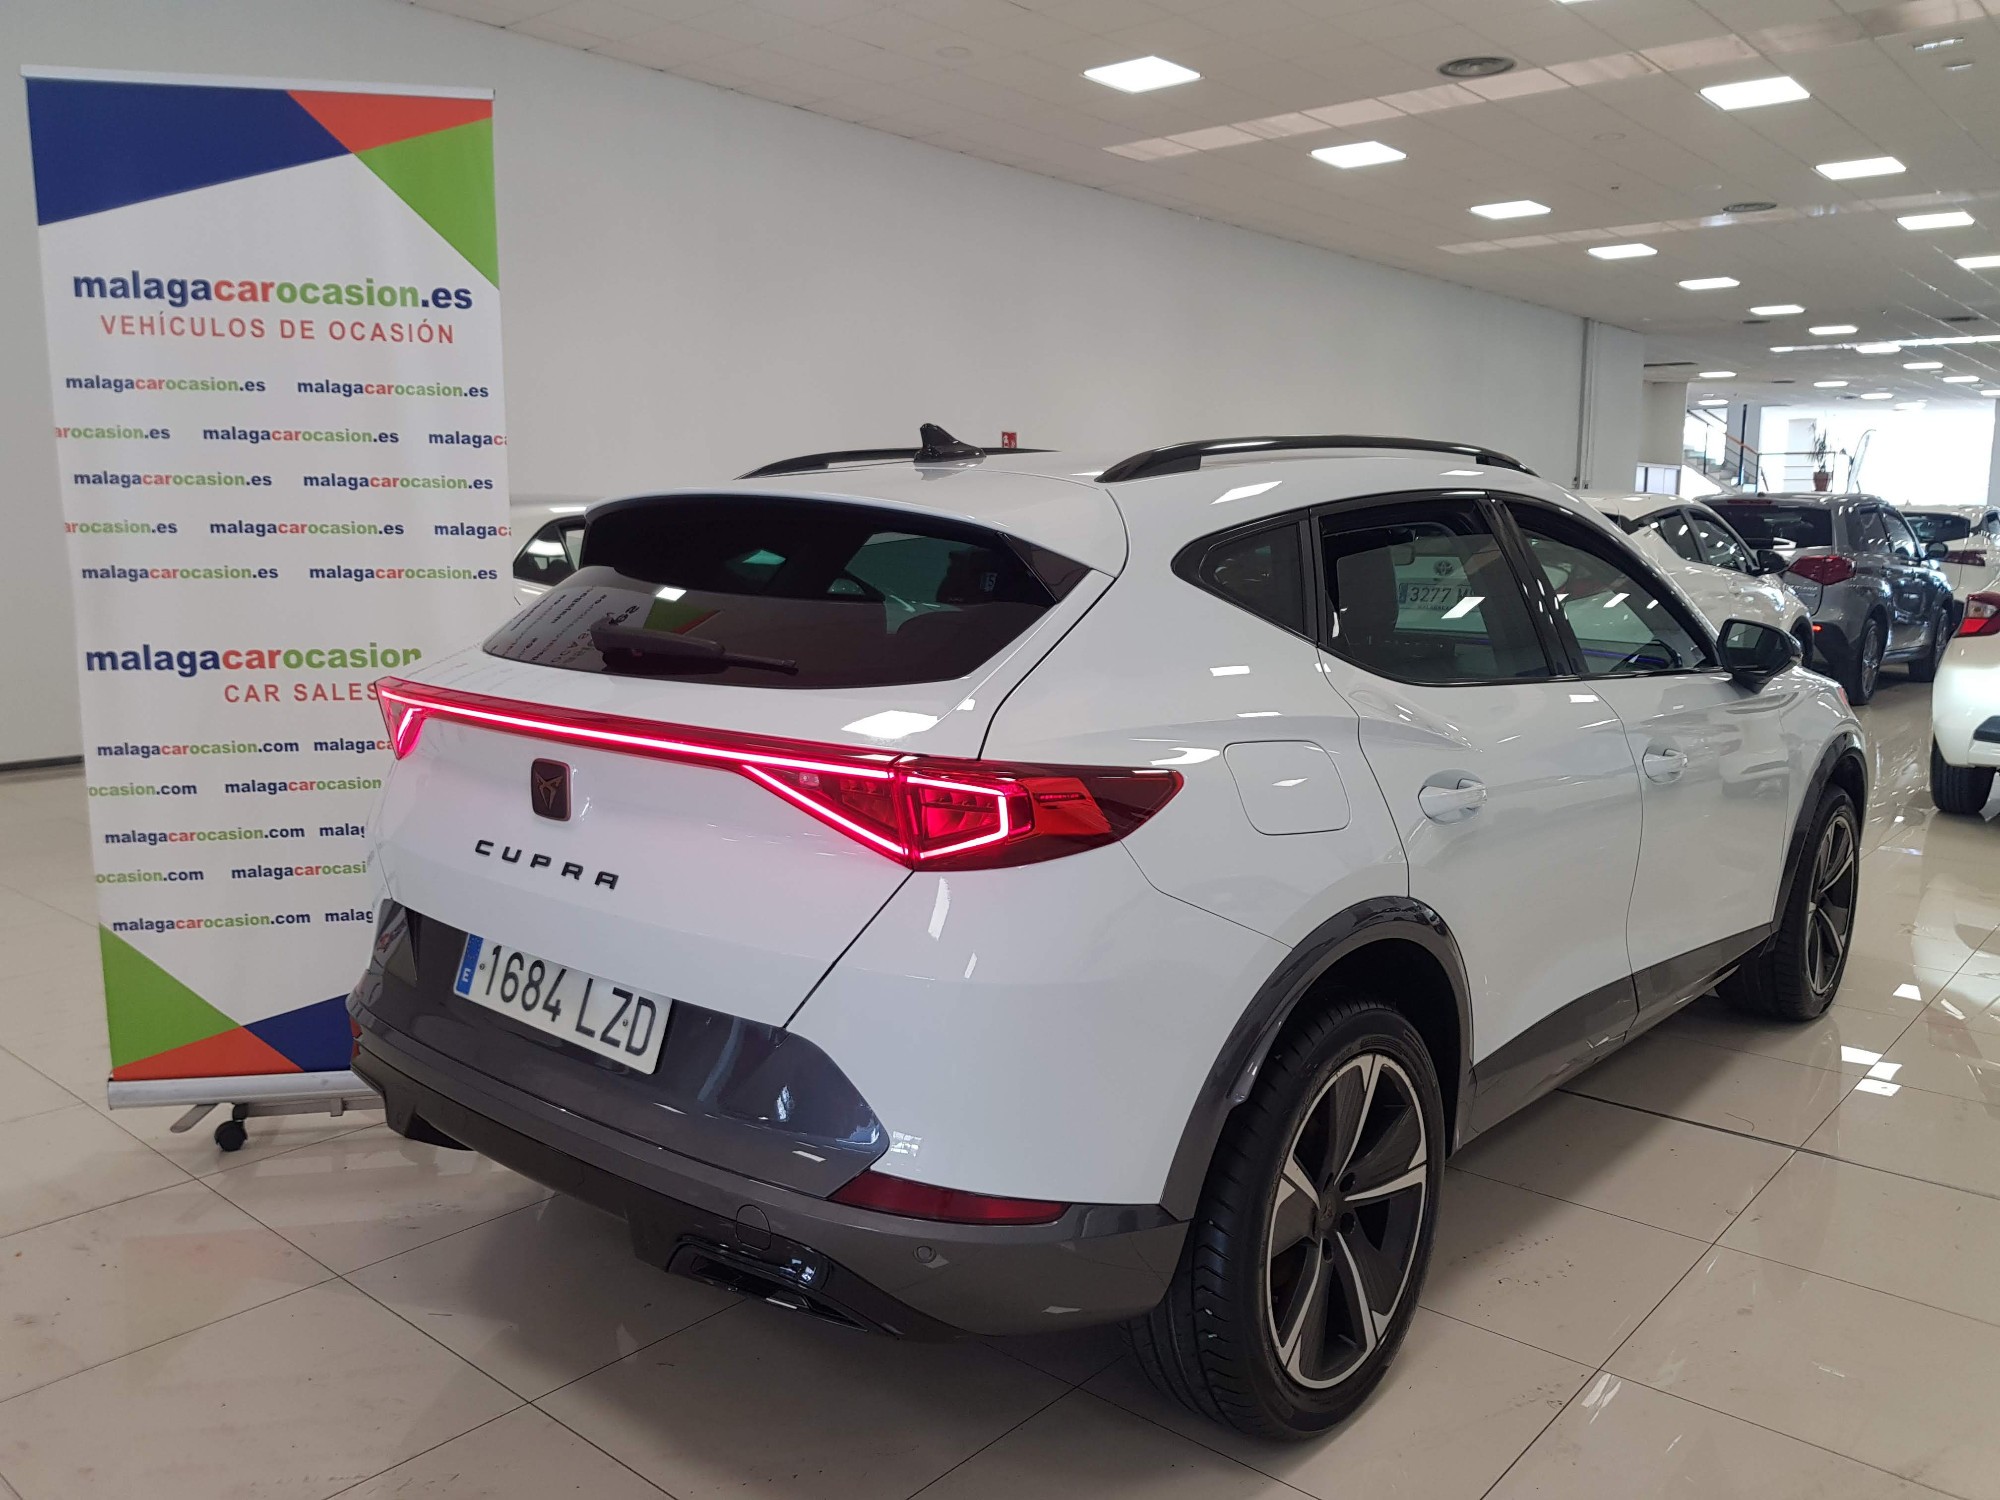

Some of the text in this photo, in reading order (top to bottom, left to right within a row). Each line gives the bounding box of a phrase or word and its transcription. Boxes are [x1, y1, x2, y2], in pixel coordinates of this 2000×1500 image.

[73, 269, 473, 309] malagacarocasion.es
[101, 311, 454, 344] VEHÍCULOS DE OCASIÓN
[65, 374, 489, 397] malagacarocasion.es malagacarocasion.es
[203, 425, 400, 444] malagacarocasion.es
[428, 430, 507, 448] malagac
[74, 470, 494, 490] malagacarocasion.es malagacarocasion.es
[209, 519, 405, 537] malagacarocasion.es
[434, 522, 511, 539] malagac
[82, 565, 498, 583] malagacarocasion.es malagacarocasion.es
[1409, 586, 1452, 603] 3277
[86, 642, 422, 677] malagacarocasion
[224, 683, 378, 703] CAR SALES
[97, 739, 300, 759] malagacarocasion.com
[88, 776, 381, 797] ocasion.com malagacarocasion
[105, 827, 305, 846] malagacarocasion.com
[95, 860, 366, 883] ocasion.com malagacarocasi
[475, 839, 620, 891] CUPRA
[112, 913, 311, 933] malagacarocasion.com
[461, 944, 657, 1056] E 1684 LZD
